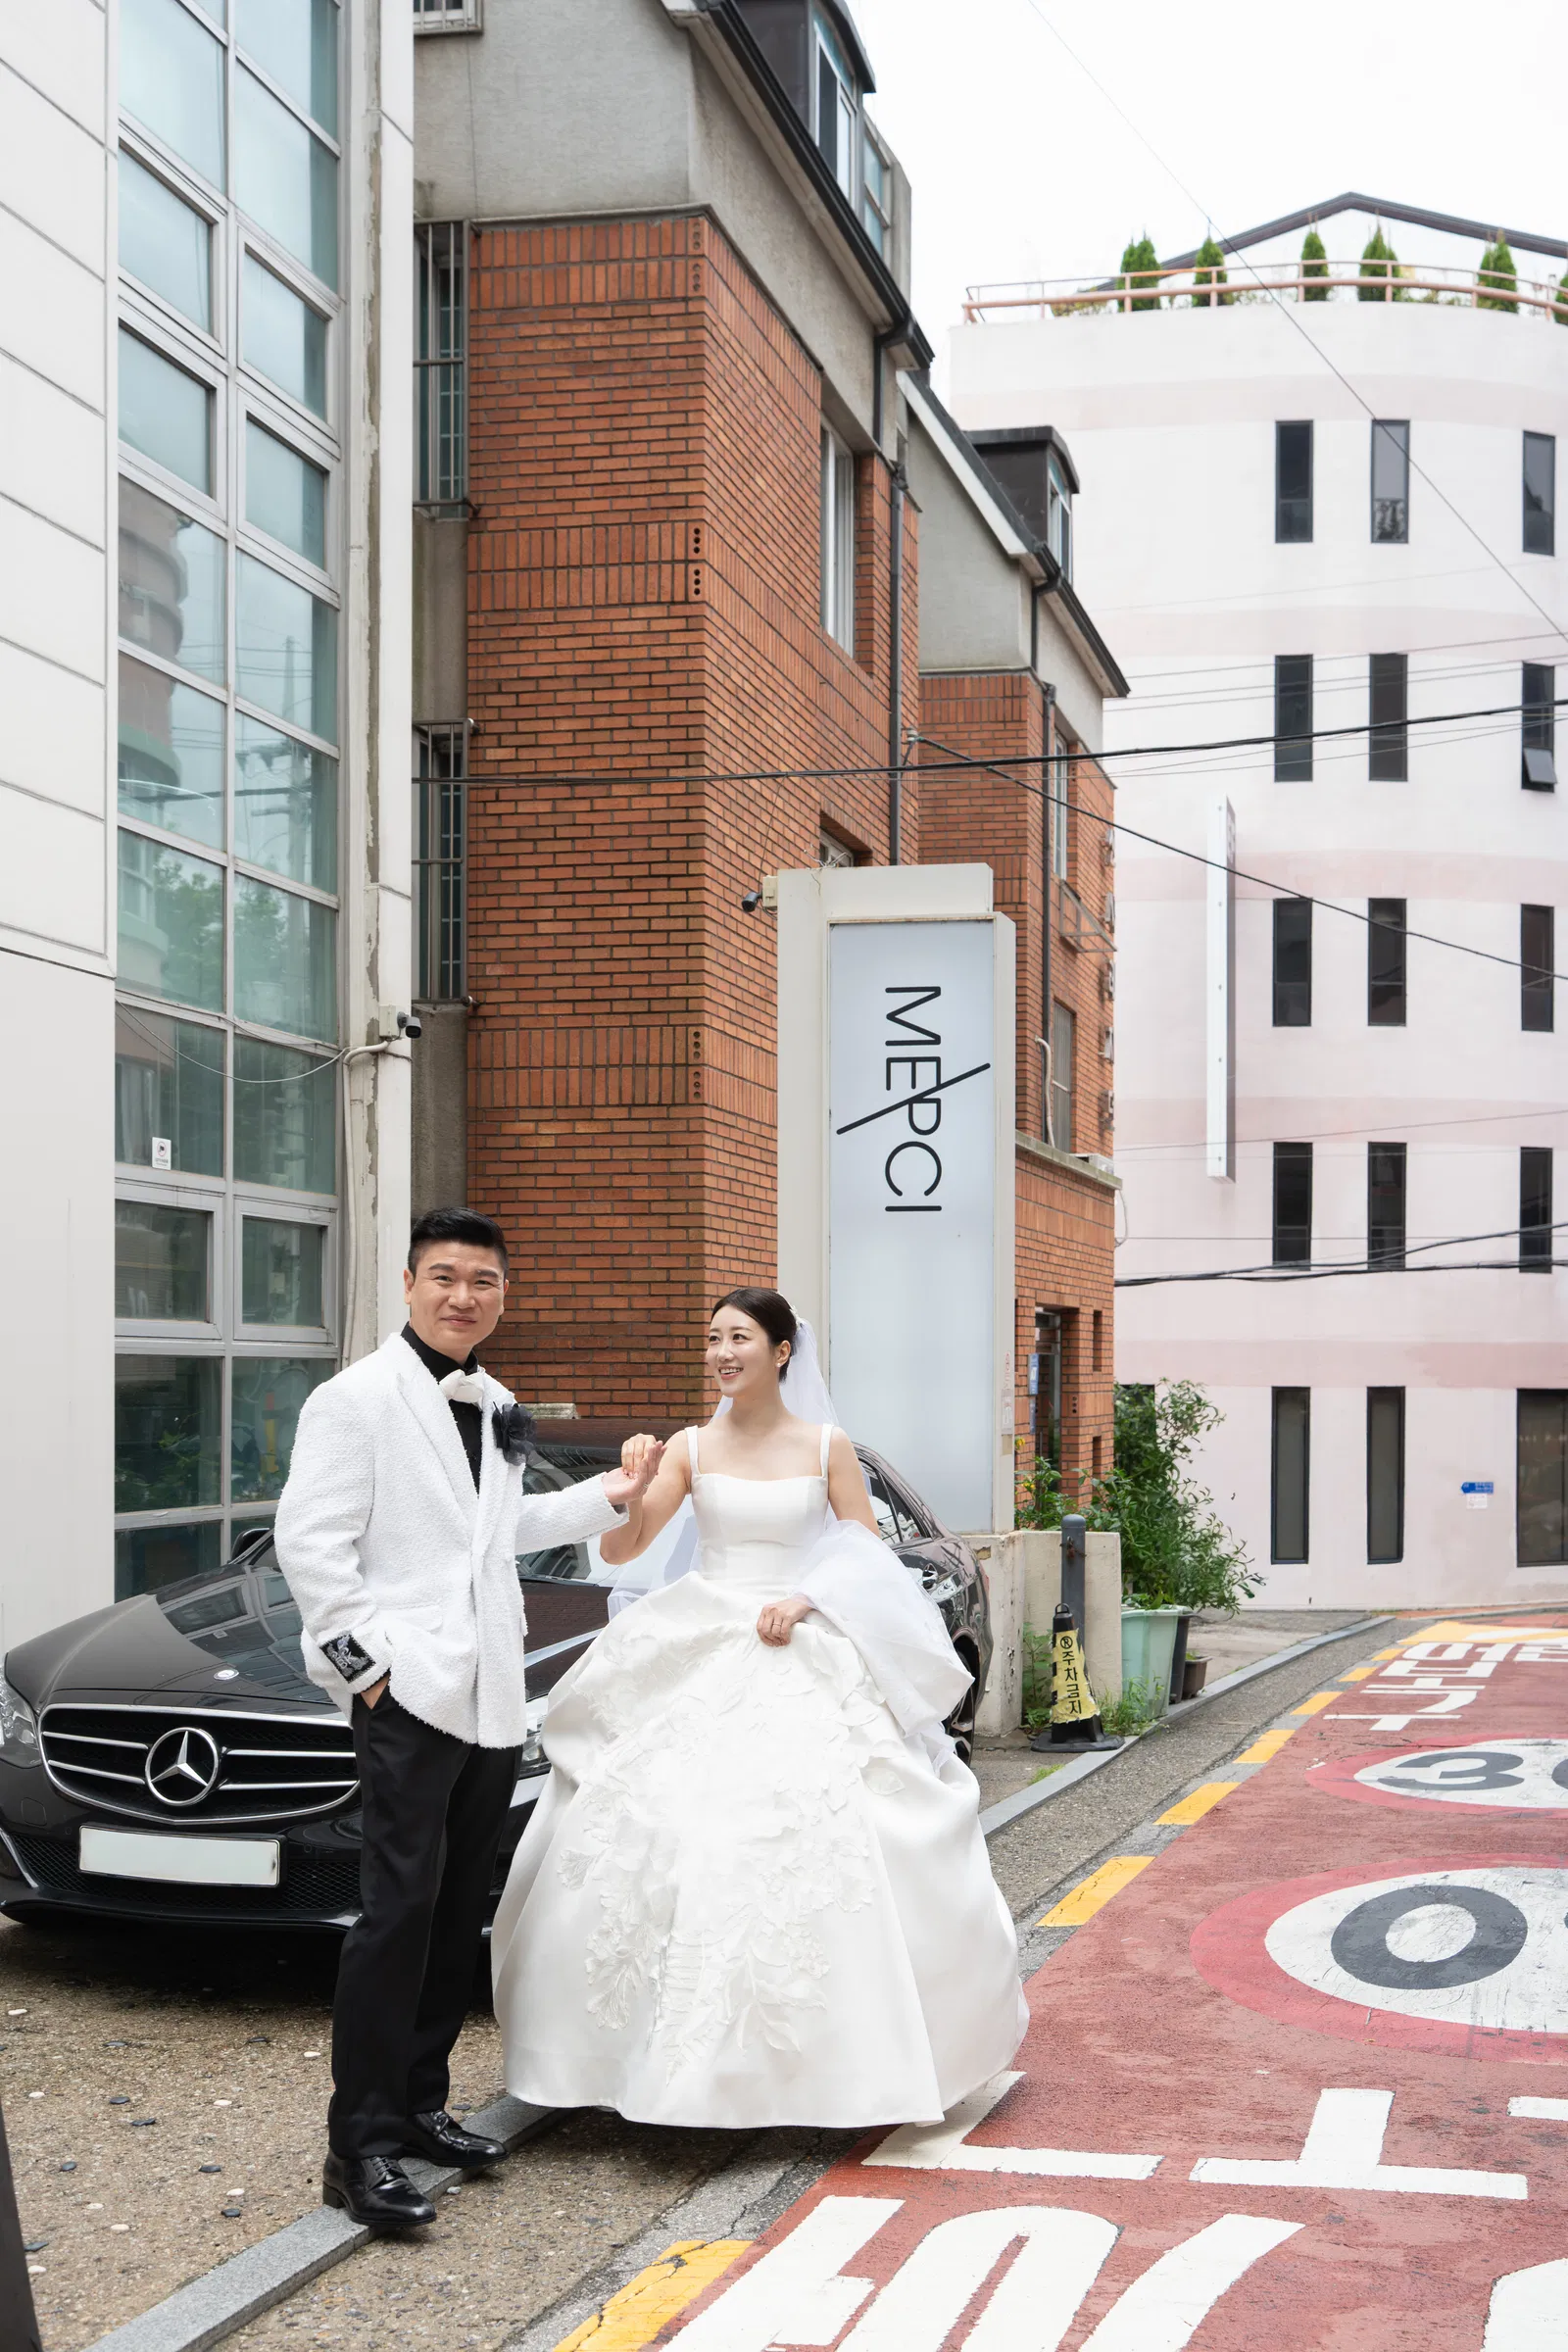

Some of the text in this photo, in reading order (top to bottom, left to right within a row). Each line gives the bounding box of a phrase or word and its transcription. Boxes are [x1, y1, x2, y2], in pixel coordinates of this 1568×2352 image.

[1061, 1650, 1083, 1715] 주차금지
[1377, 1750, 1568, 1791] 3
[1330, 1884, 1568, 1990] 0
